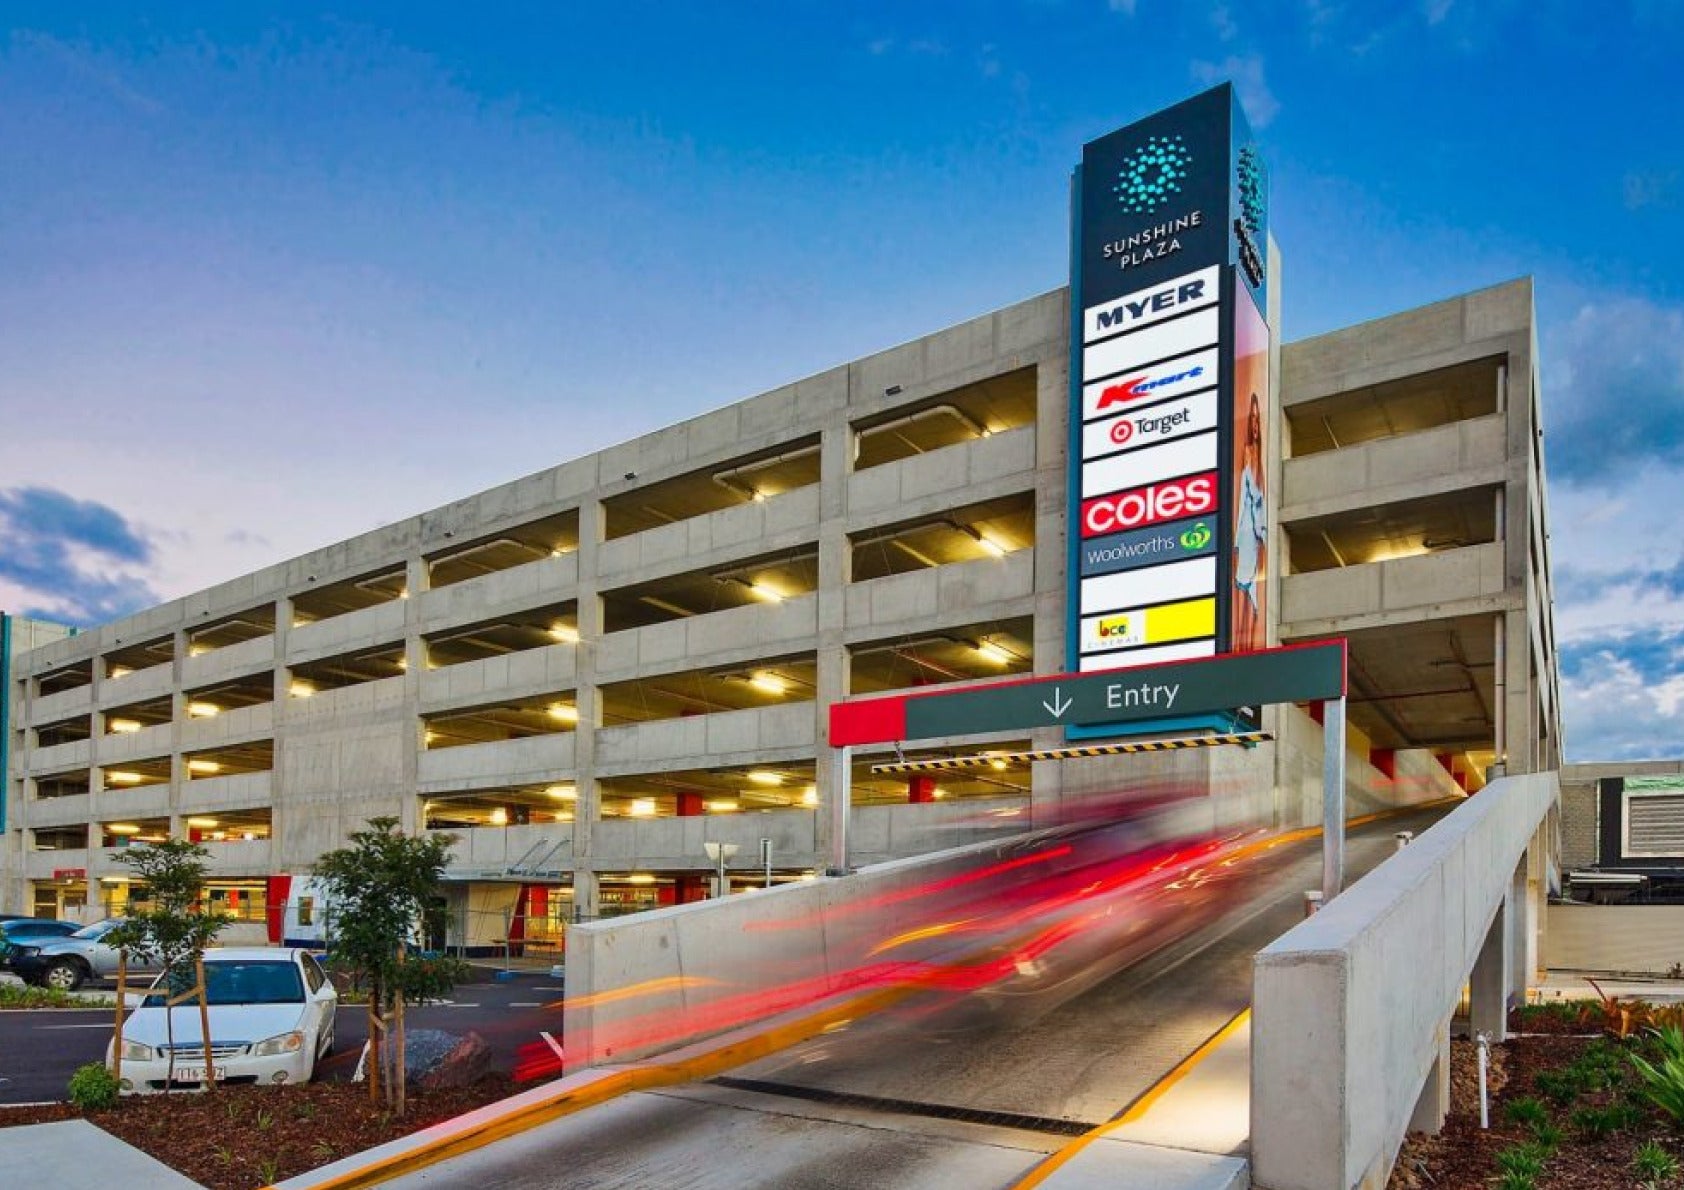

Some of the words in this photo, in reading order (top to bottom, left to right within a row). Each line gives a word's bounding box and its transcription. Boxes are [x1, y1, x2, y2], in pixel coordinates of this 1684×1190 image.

[1104, 210, 1202, 258] SUNSHINE
[1120, 238, 1182, 269] PLAZA
[1096, 278, 1205, 330] MYER
[1096, 366, 1204, 410] Kmart
[1135, 407, 1190, 434] Target
[1086, 479, 1211, 532] coles
[1087, 536, 1175, 564] woolworths
[1107, 683, 1180, 709] Entry
